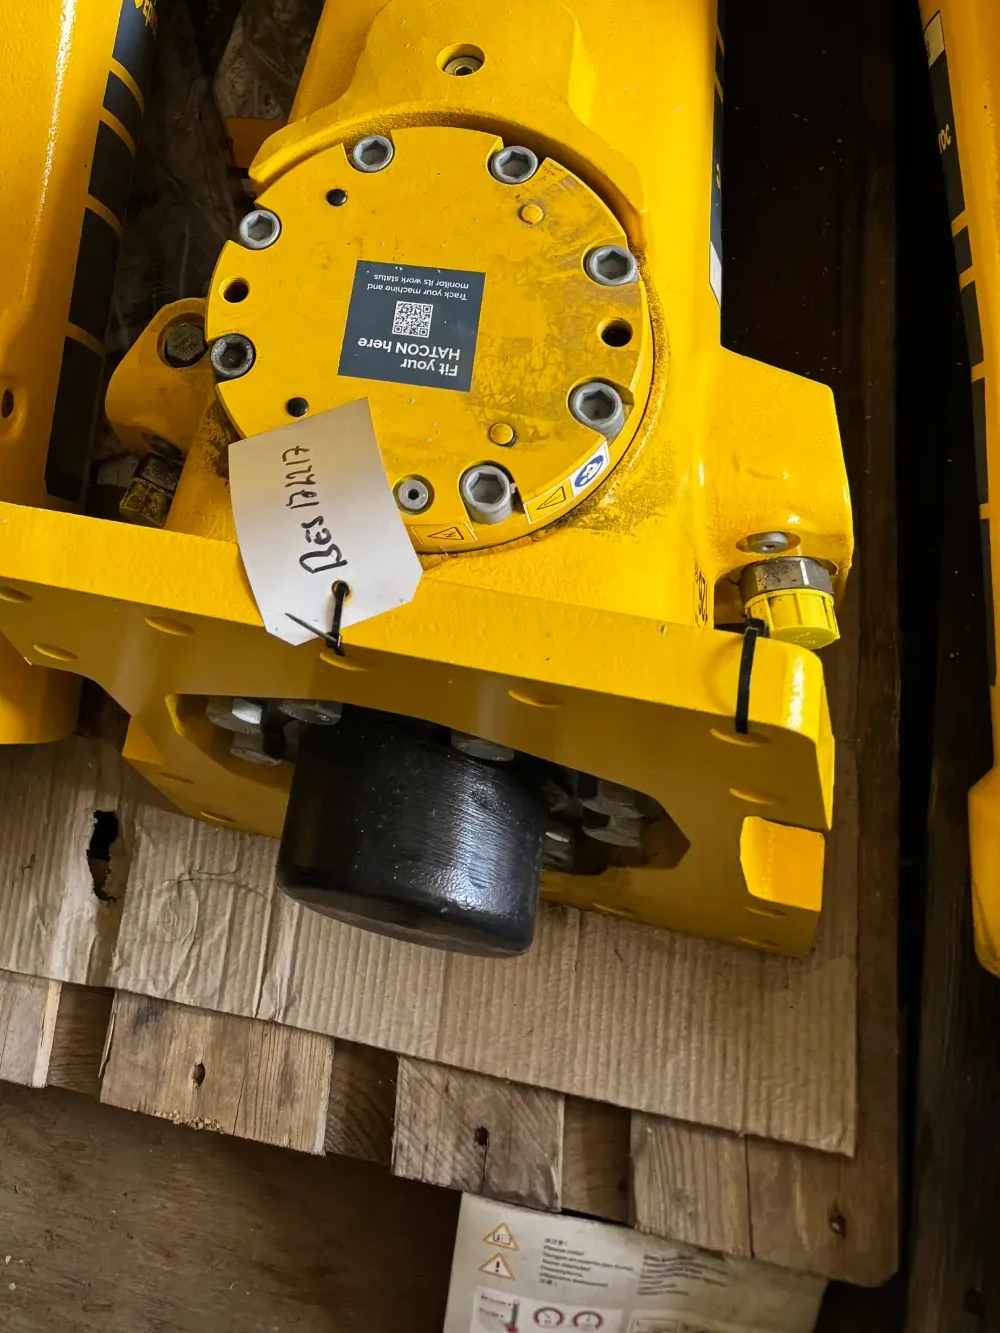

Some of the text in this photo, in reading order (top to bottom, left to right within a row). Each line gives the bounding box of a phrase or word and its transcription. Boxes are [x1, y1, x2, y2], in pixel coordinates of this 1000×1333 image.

[373, 274, 469, 289] monitor its work status
[367, 283, 468, 301] Track your machine and
[357, 337, 461, 361] HATCON here
[400, 358, 459, 377] Fit your
[299, 515, 348, 574] BES
